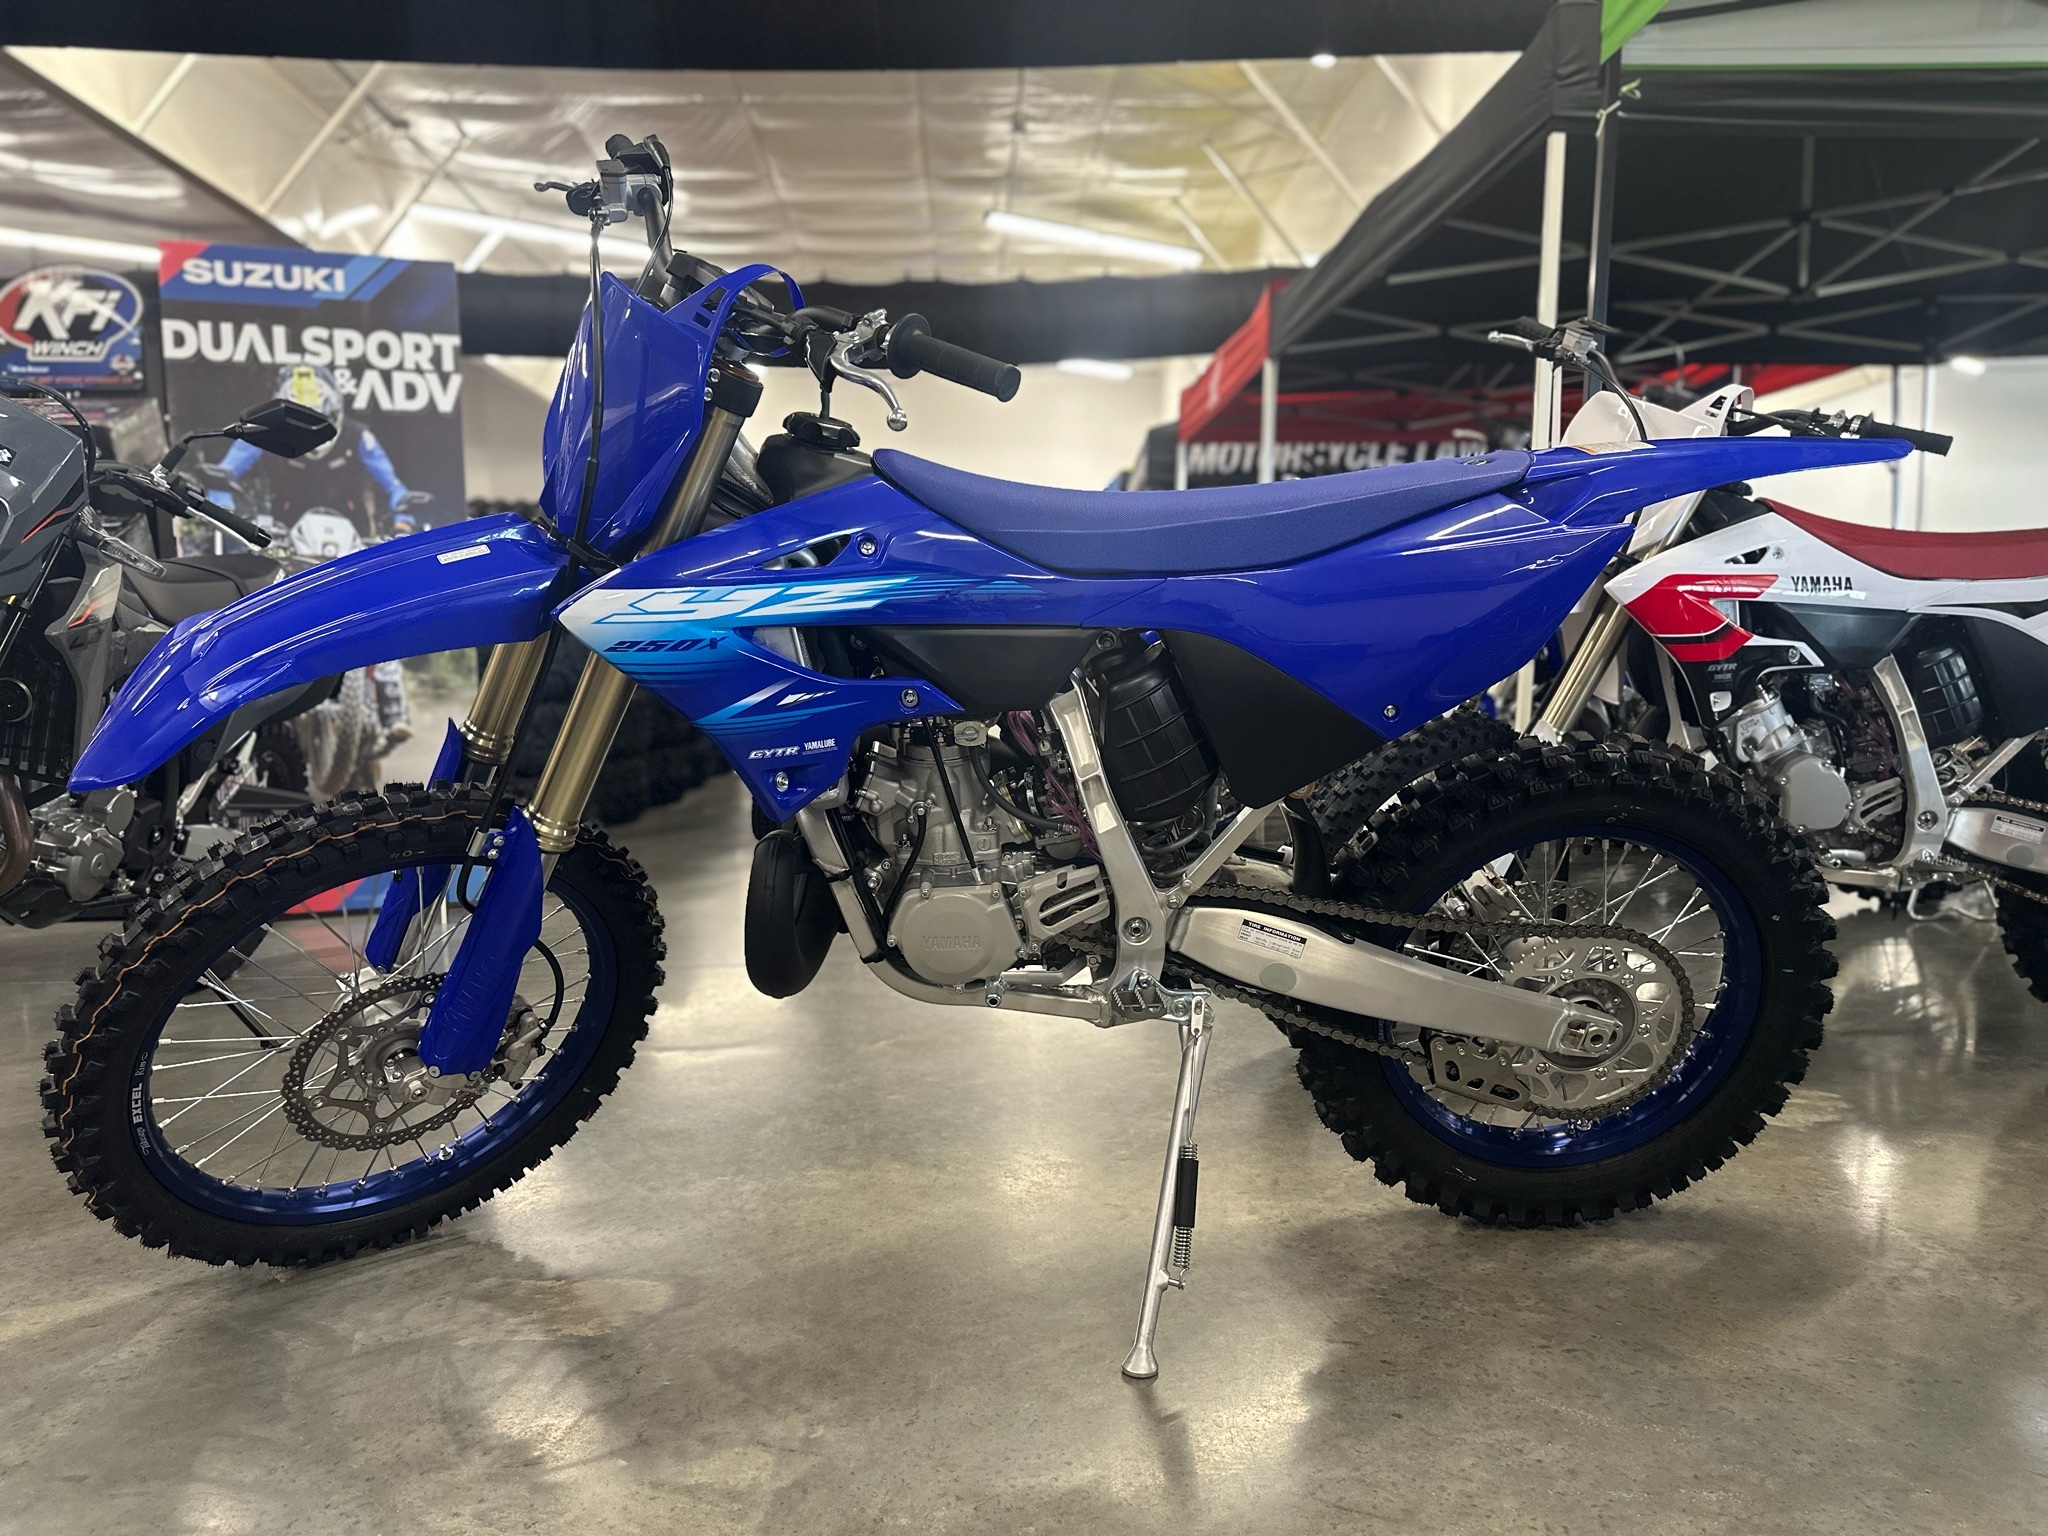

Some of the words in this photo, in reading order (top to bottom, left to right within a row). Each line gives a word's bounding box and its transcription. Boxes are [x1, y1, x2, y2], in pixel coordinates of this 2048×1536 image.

[182, 258, 345, 292] SUZUKI
[33, 340, 104, 356] WINCH
[1791, 576, 1854, 593] YAMAHA
[592, 576, 918, 624] YZ
[603, 636, 728, 653] 250X
[748, 745, 800, 760] GYTR
[803, 738, 836, 751] YAMALUBE
[1248, 921, 1261, 929] TIRE
[1263, 927, 1301, 942] INFORMATION
[921, 935, 982, 951] YAMAHA
[131, 1082, 143, 1125] EXCEL
